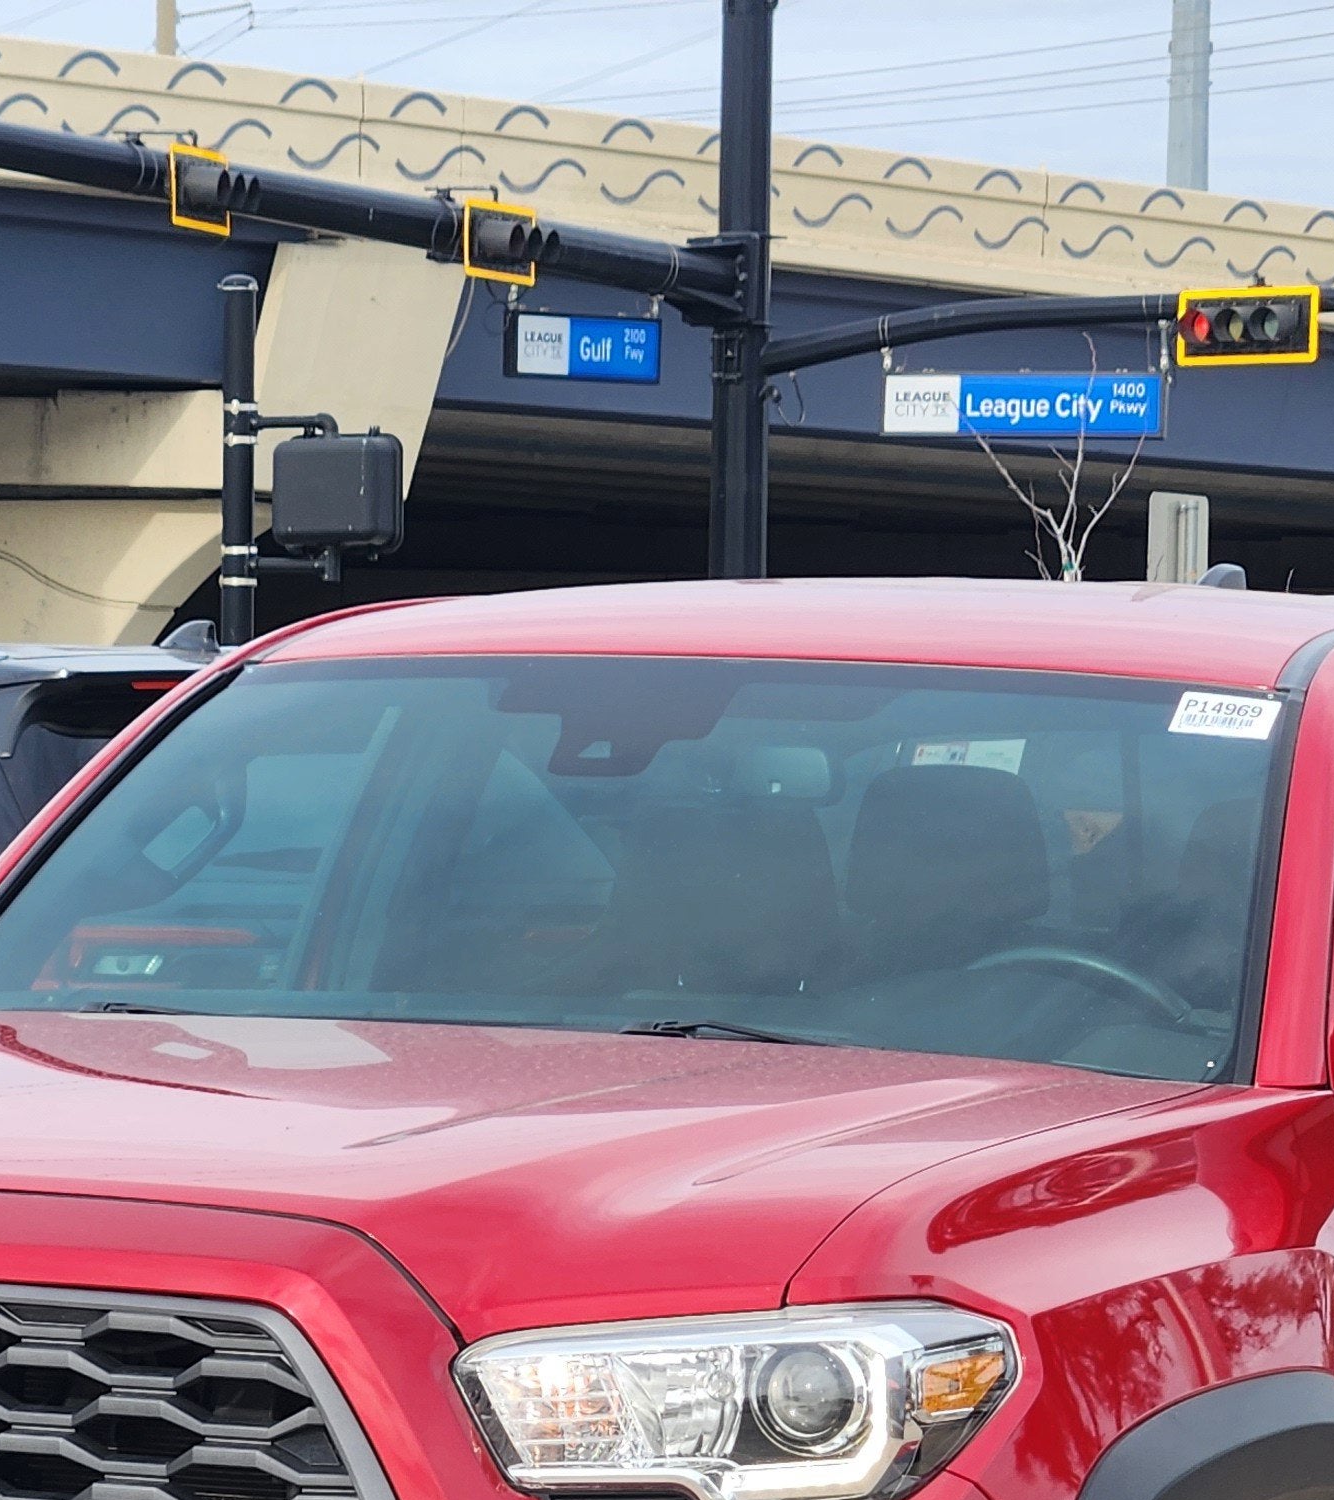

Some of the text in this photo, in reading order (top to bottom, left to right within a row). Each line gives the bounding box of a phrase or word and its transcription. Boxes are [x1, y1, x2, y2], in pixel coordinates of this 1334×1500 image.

[524, 331, 563, 344] LEAGUE
[624, 328, 646, 343] 2100
[579, 335, 612, 362] Gulf
[624, 345, 645, 364] Fwy
[895, 391, 951, 402] LEAGUE
[1112, 382, 1146, 397] 1400
[894, 405, 930, 417] CITY
[965, 392, 1104, 425] League City
[1110, 401, 1148, 417] Pkwy
[1184, 698, 1263, 718] P14969
